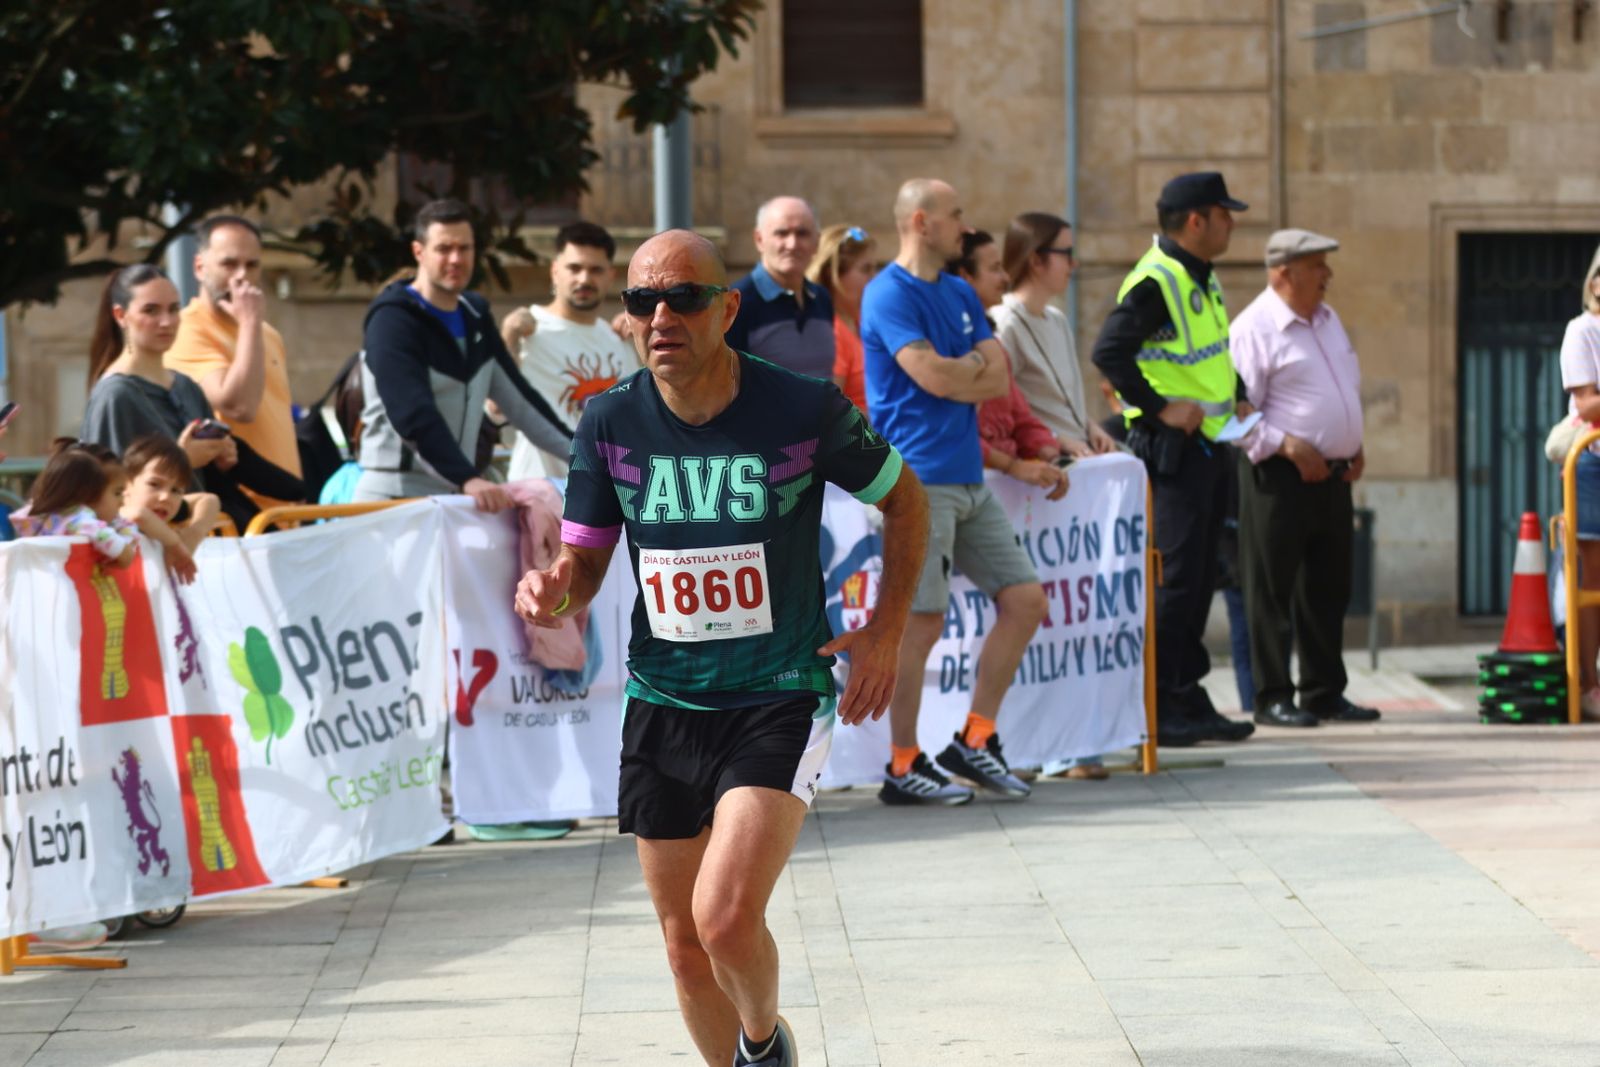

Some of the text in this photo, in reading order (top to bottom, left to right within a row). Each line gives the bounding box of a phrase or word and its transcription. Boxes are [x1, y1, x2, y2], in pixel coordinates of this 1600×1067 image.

[640, 454, 768, 524] AVS
[644, 550, 760, 565] DÍA DE CASTILLA Y LEÓN
[1114, 514, 1144, 556] DE
[646, 566, 763, 616] 1860
[940, 653, 970, 694] DE
[1074, 636, 1086, 676] Y
[1093, 622, 1143, 673] LEÓN
[504, 712, 522, 728] DE
